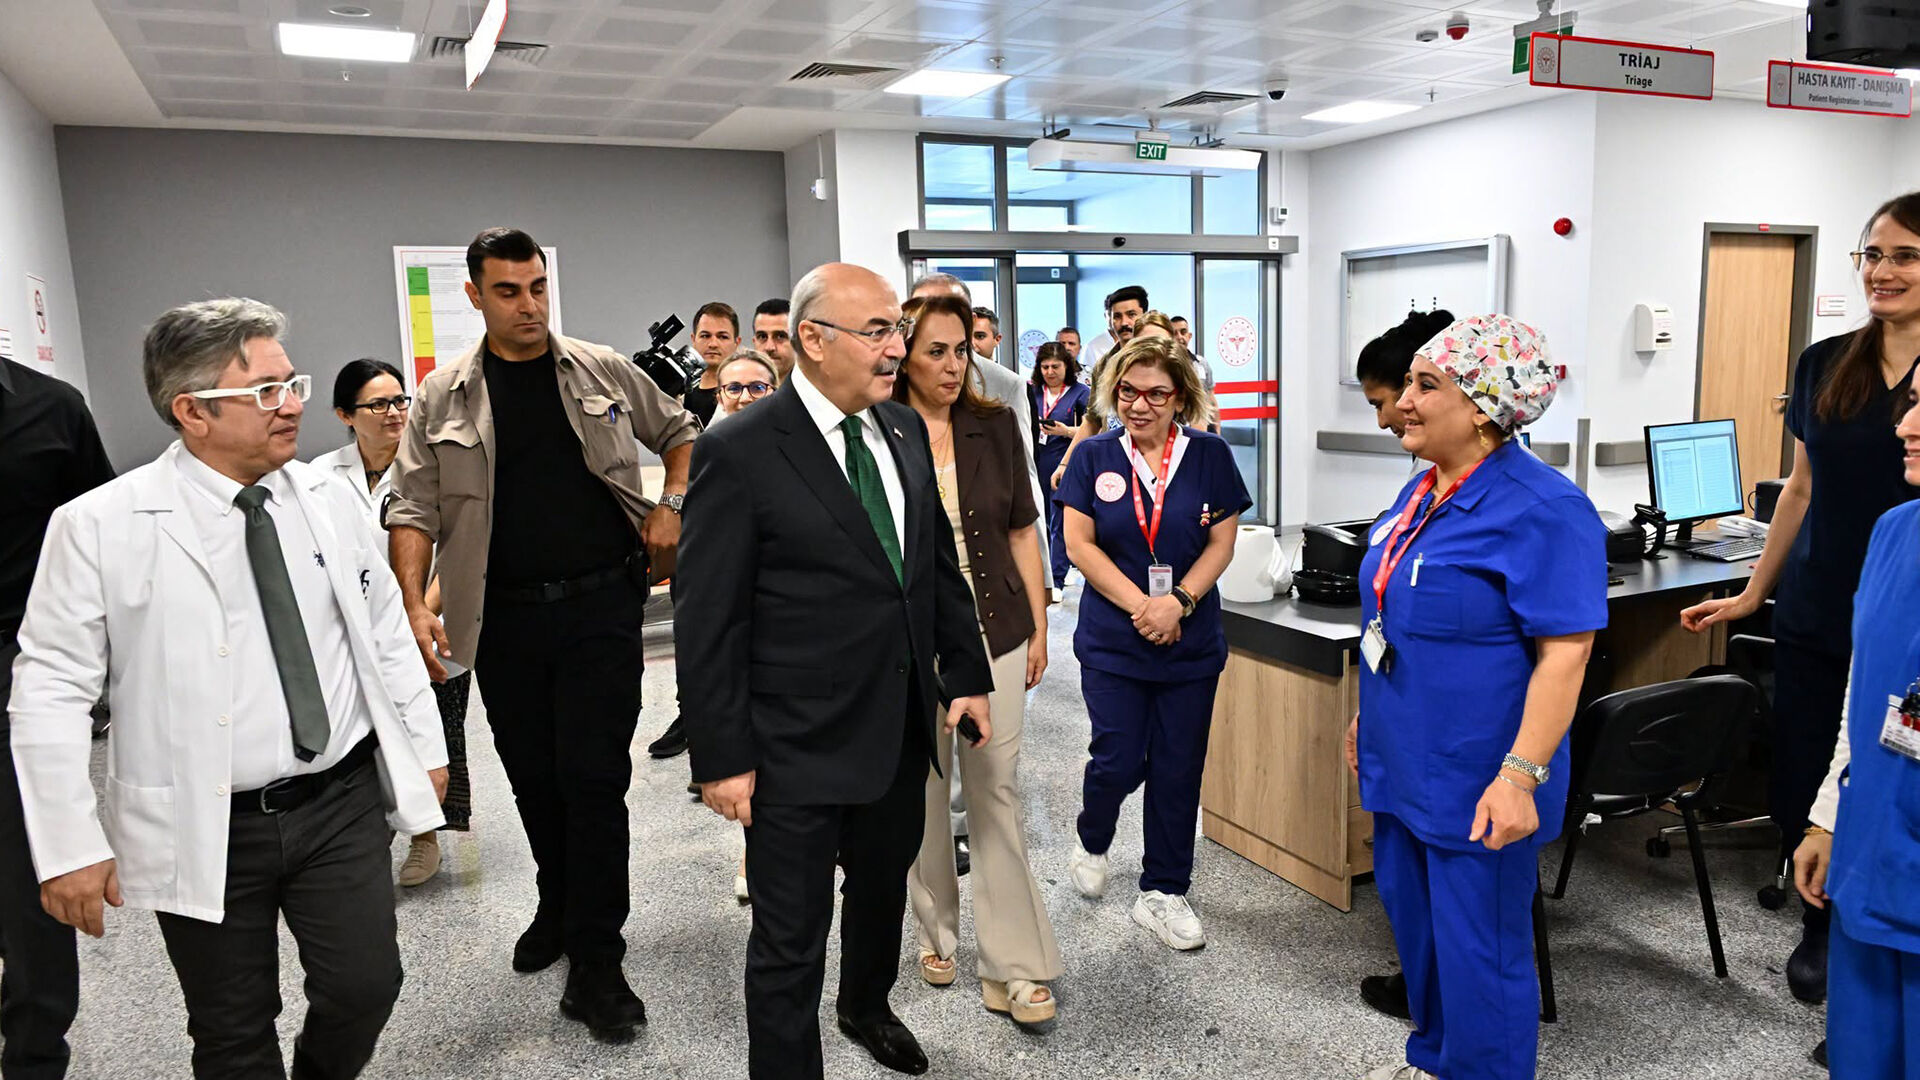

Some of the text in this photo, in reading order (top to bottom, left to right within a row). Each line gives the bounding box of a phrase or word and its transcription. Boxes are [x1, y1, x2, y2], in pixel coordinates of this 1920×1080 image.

[1619, 52, 1660, 69] TRİAJ
[1625, 74, 1653, 88] Triage
[1798, 71, 1829, 87] HASTA
[1830, 75, 1857, 90] KAYIT
[1863, 78, 1904, 96] DANIŞMA
[1808, 93, 1828, 103] Patient
[1139, 144, 1165, 158] EXIT
